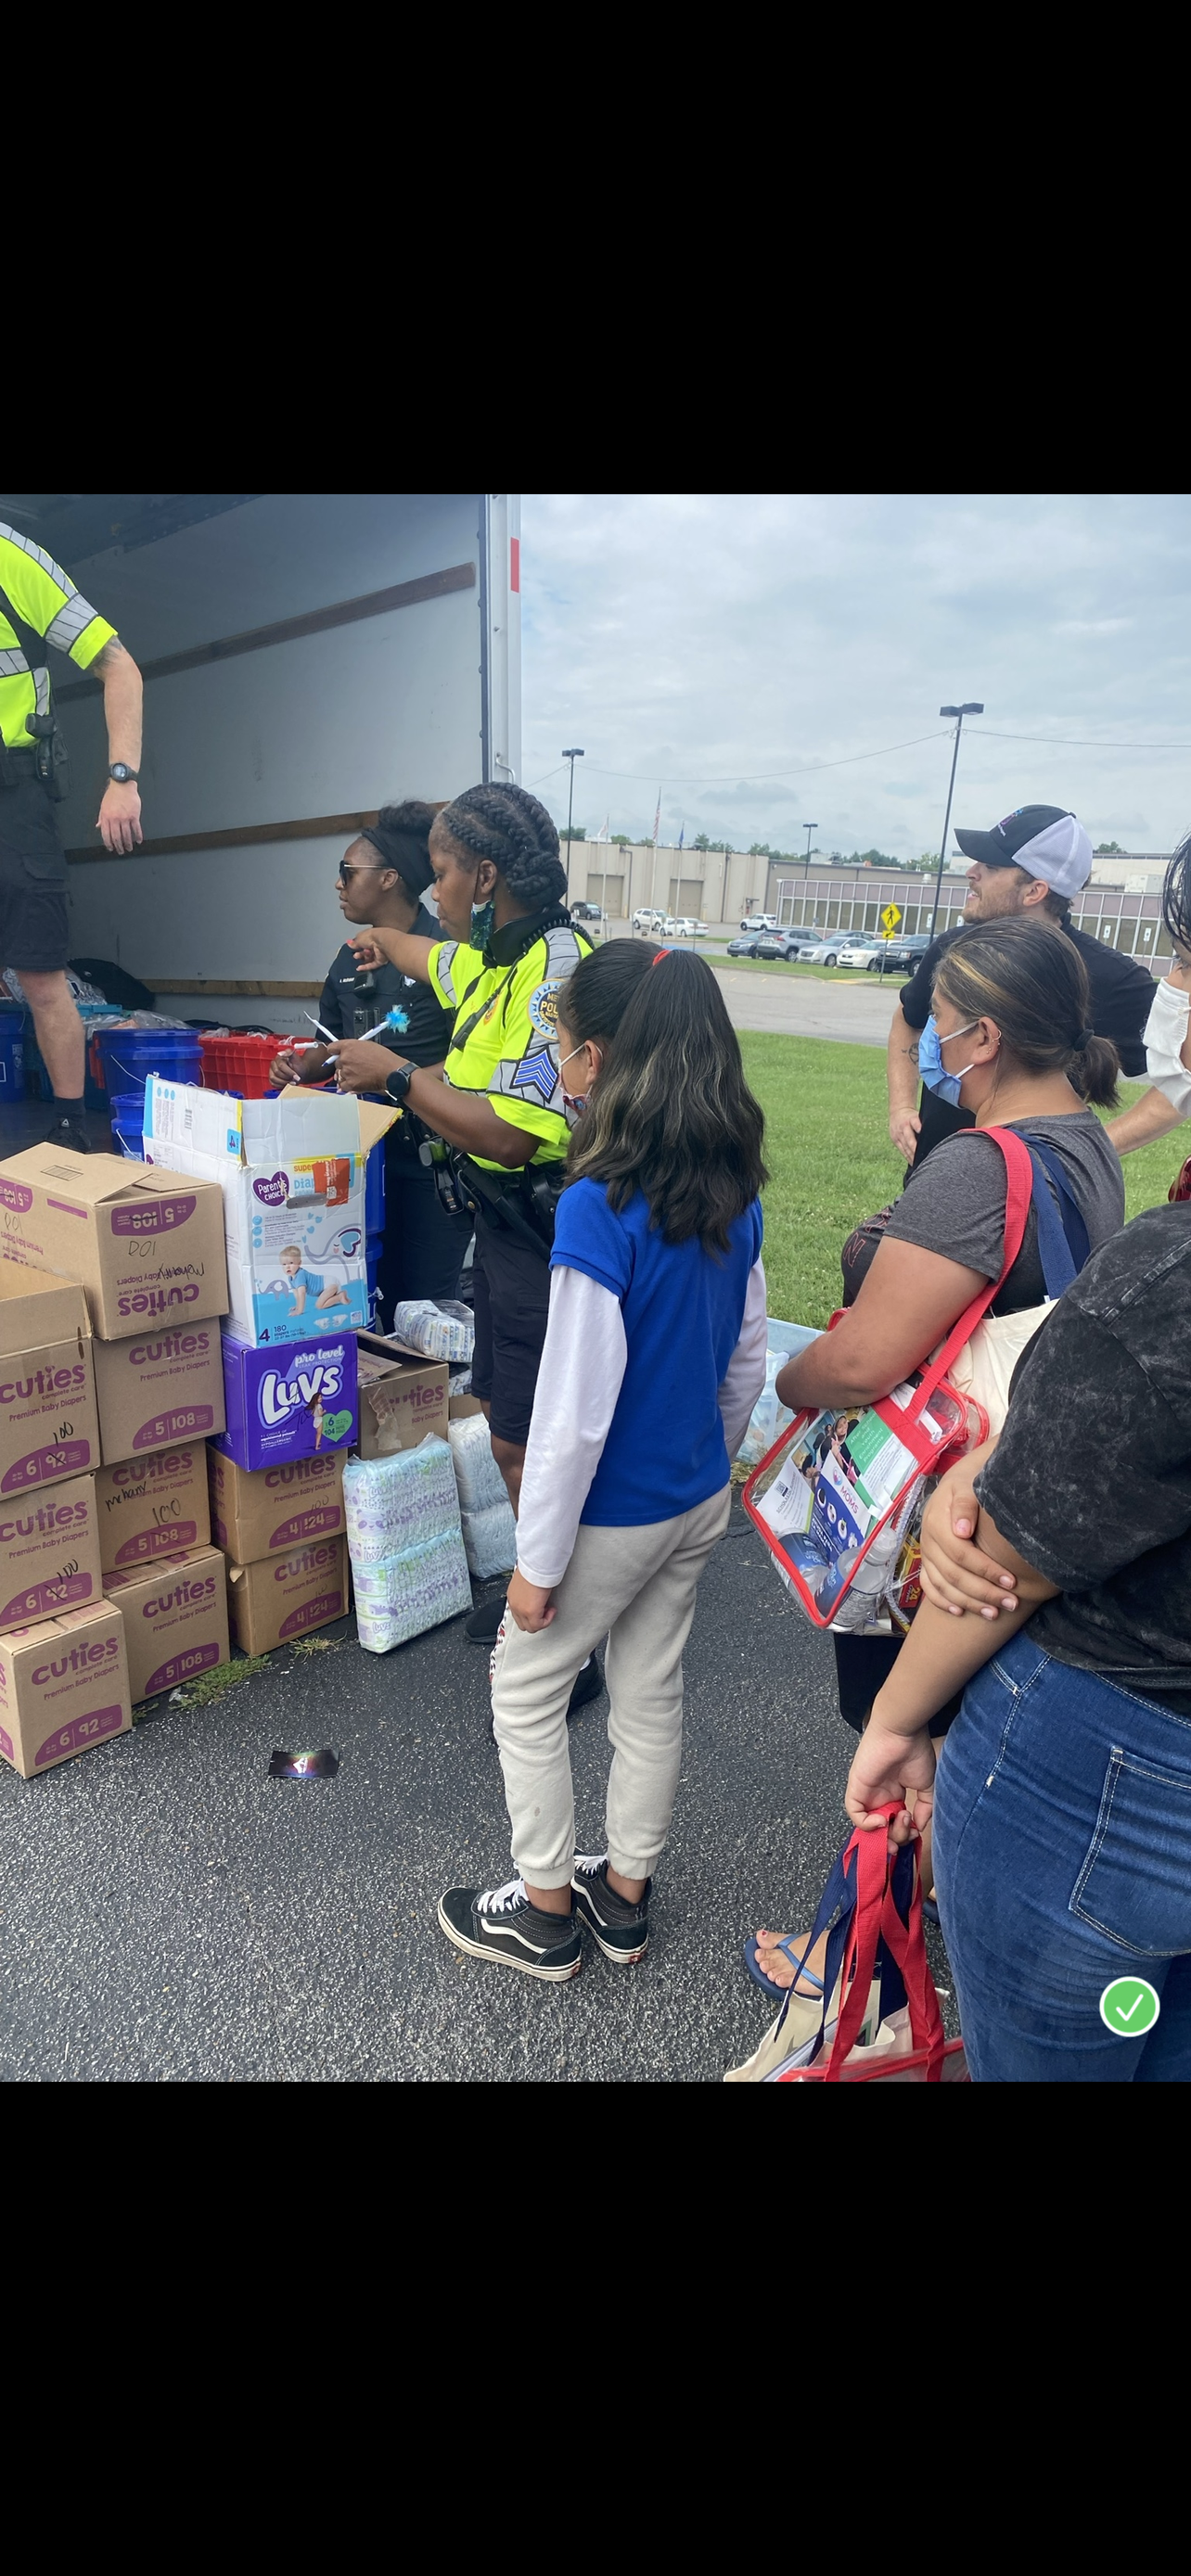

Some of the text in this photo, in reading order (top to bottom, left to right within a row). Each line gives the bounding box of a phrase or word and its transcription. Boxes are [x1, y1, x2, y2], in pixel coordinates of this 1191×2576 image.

[540, 1001, 558, 1014] POL
[132, 1211, 158, 1229] 108
[165, 1208, 174, 1222] 5
[117, 1276, 142, 1285] Diapers
[134, 1284, 160, 1293] complete
[118, 1283, 199, 1317] cuties
[259, 1328, 270, 1342] 4
[129, 1333, 209, 1365] cuties
[170, 1354, 194, 1363] complete
[295, 1345, 343, 1367] pro level
[140, 1371, 168, 1382] Premium
[186, 1360, 210, 1371] Diapers
[0, 1365, 84, 1404] cuties
[42, 1389, 69, 1400] complete
[390, 1385, 443, 1408] ties
[9, 1396, 86, 1422] Premium Baby Diapers
[156, 1422, 164, 1435] 5
[172, 1412, 195, 1430] 108
[328, 1417, 334, 1426] 6
[851, 1413, 876, 1445] After Schoo
[859, 1428, 883, 1460] Enrichment
[862, 1427, 870, 1439] and
[862, 1430, 875, 1446] Youth
[864, 1436, 883, 1462] Programs
[26, 1460, 36, 1475] 6
[45, 1451, 66, 1468] 92
[112, 1452, 193, 1486] cuties
[265, 1455, 336, 1487] cuties
[153, 1473, 178, 1483] complete
[153, 1478, 193, 1494] Baby Diapers
[301, 1475, 323, 1485] complete
[274, 1481, 336, 1503] Premium Baby Diapers
[840, 1486, 859, 1514] MOMS
[0, 1501, 87, 1542] cuties
[43, 1525, 70, 1537] complete
[289, 1523, 298, 1534] 4
[8, 1530, 89, 1559] Premium Baby Diapers
[138, 1538, 147, 1550] 5
[155, 1529, 178, 1546] 108
[275, 1544, 337, 1581] cuties
[26, 1594, 36, 1609] 6
[46, 1585, 69, 1600] 92
[143, 1577, 215, 1618] cuties
[910, 1587, 921, 1600] 24
[180, 1599, 202, 1611] complete
[153, 1602, 216, 1632] Premium Baby Diapers
[297, 1611, 305, 1623] 4
[32, 1638, 118, 1685] cuties
[76, 1662, 102, 1675] complete
[166, 1664, 174, 1677] 5
[181, 1652, 202, 1671] 108
[44, 1664, 120, 1701] Premium Baby Diapers
[59, 1731, 70, 1746] 6
[79, 1718, 99, 1736] 92
